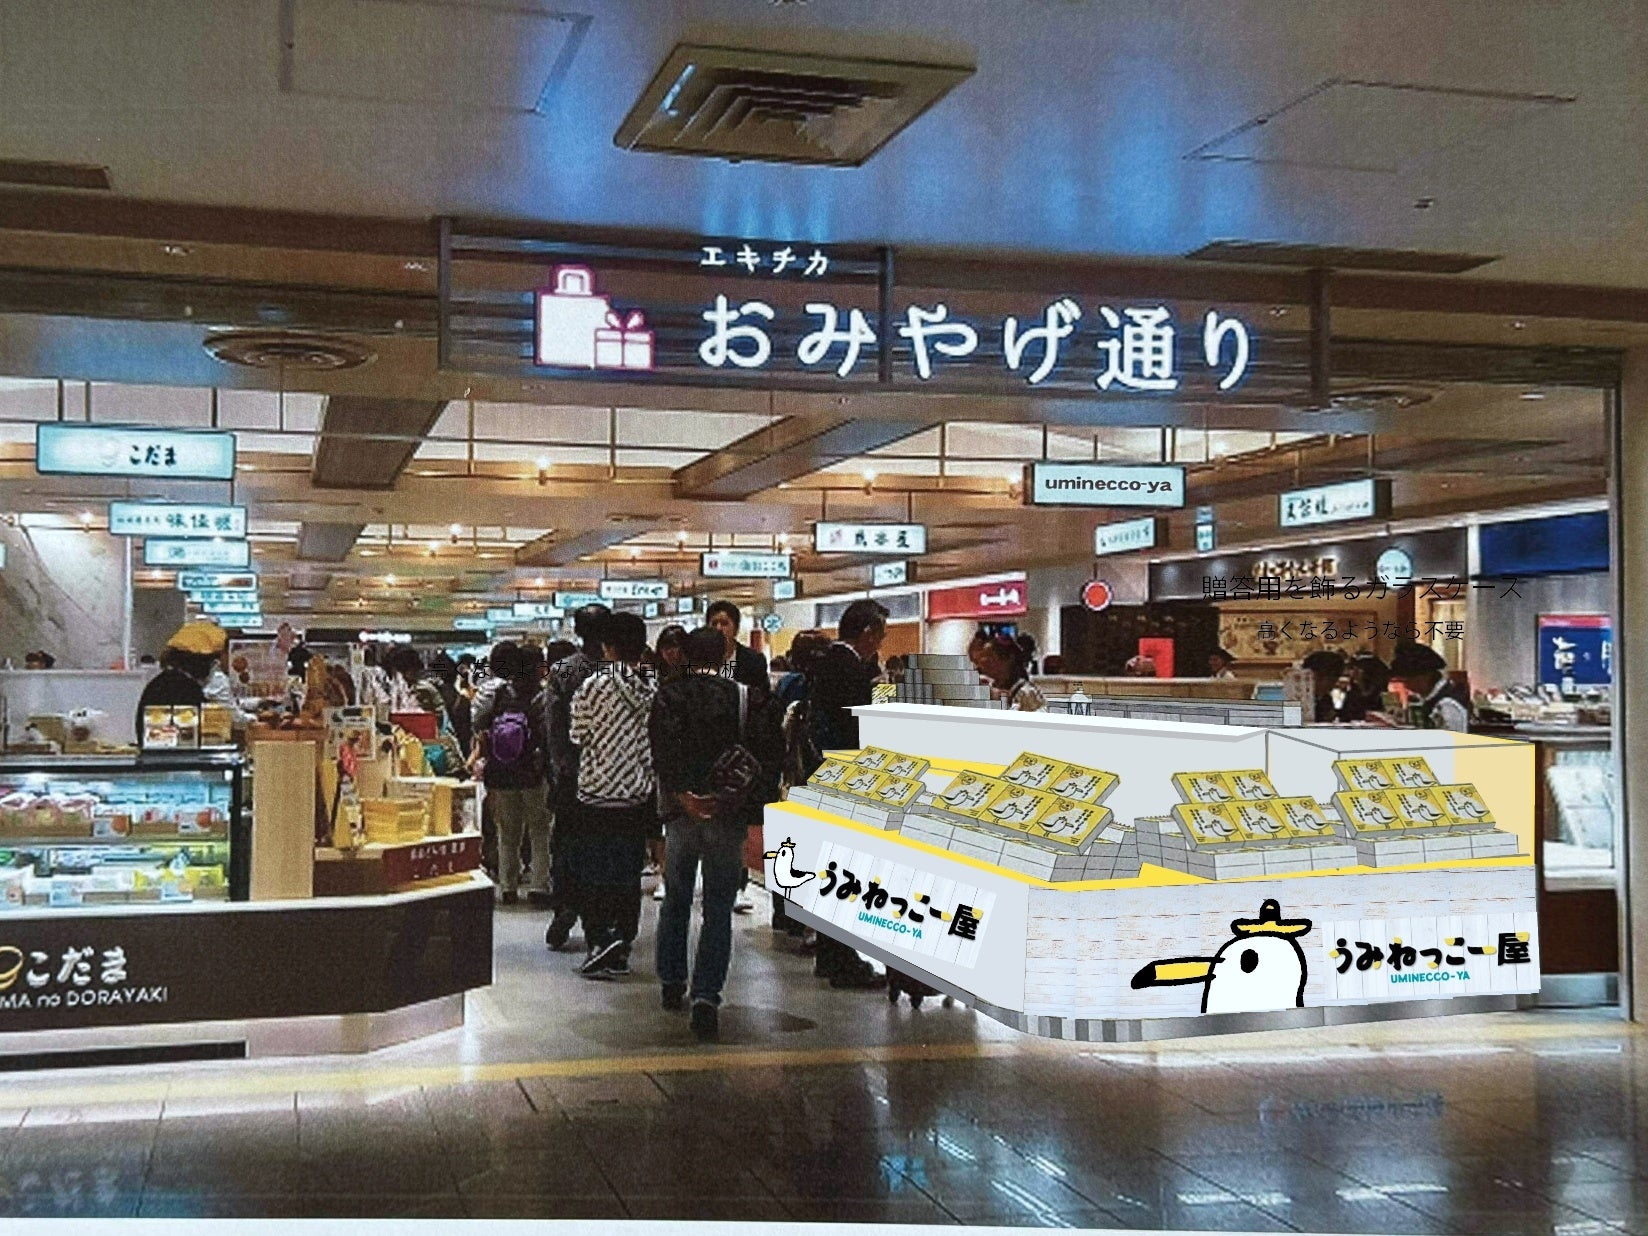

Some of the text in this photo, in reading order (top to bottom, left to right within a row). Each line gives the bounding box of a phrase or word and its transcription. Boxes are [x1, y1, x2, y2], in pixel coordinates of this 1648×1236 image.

[700, 246, 830, 277] エキチカ
[698, 294, 1250, 391] おみやげ通り
[129, 444, 178, 467] こだま
[1045, 476, 1172, 497] uminecco-ya
[819, 860, 984, 941] うみねっこー屋
[858, 911, 923, 940] UMINECCO-YA
[26, 945, 127, 988] こだま
[1329, 931, 1531, 974] うみねっこー屋
[1390, 971, 1470, 985] UMINECCO-YA
[37, 993, 61, 1008] no
[66, 986, 168, 1007] DORAYAKI
